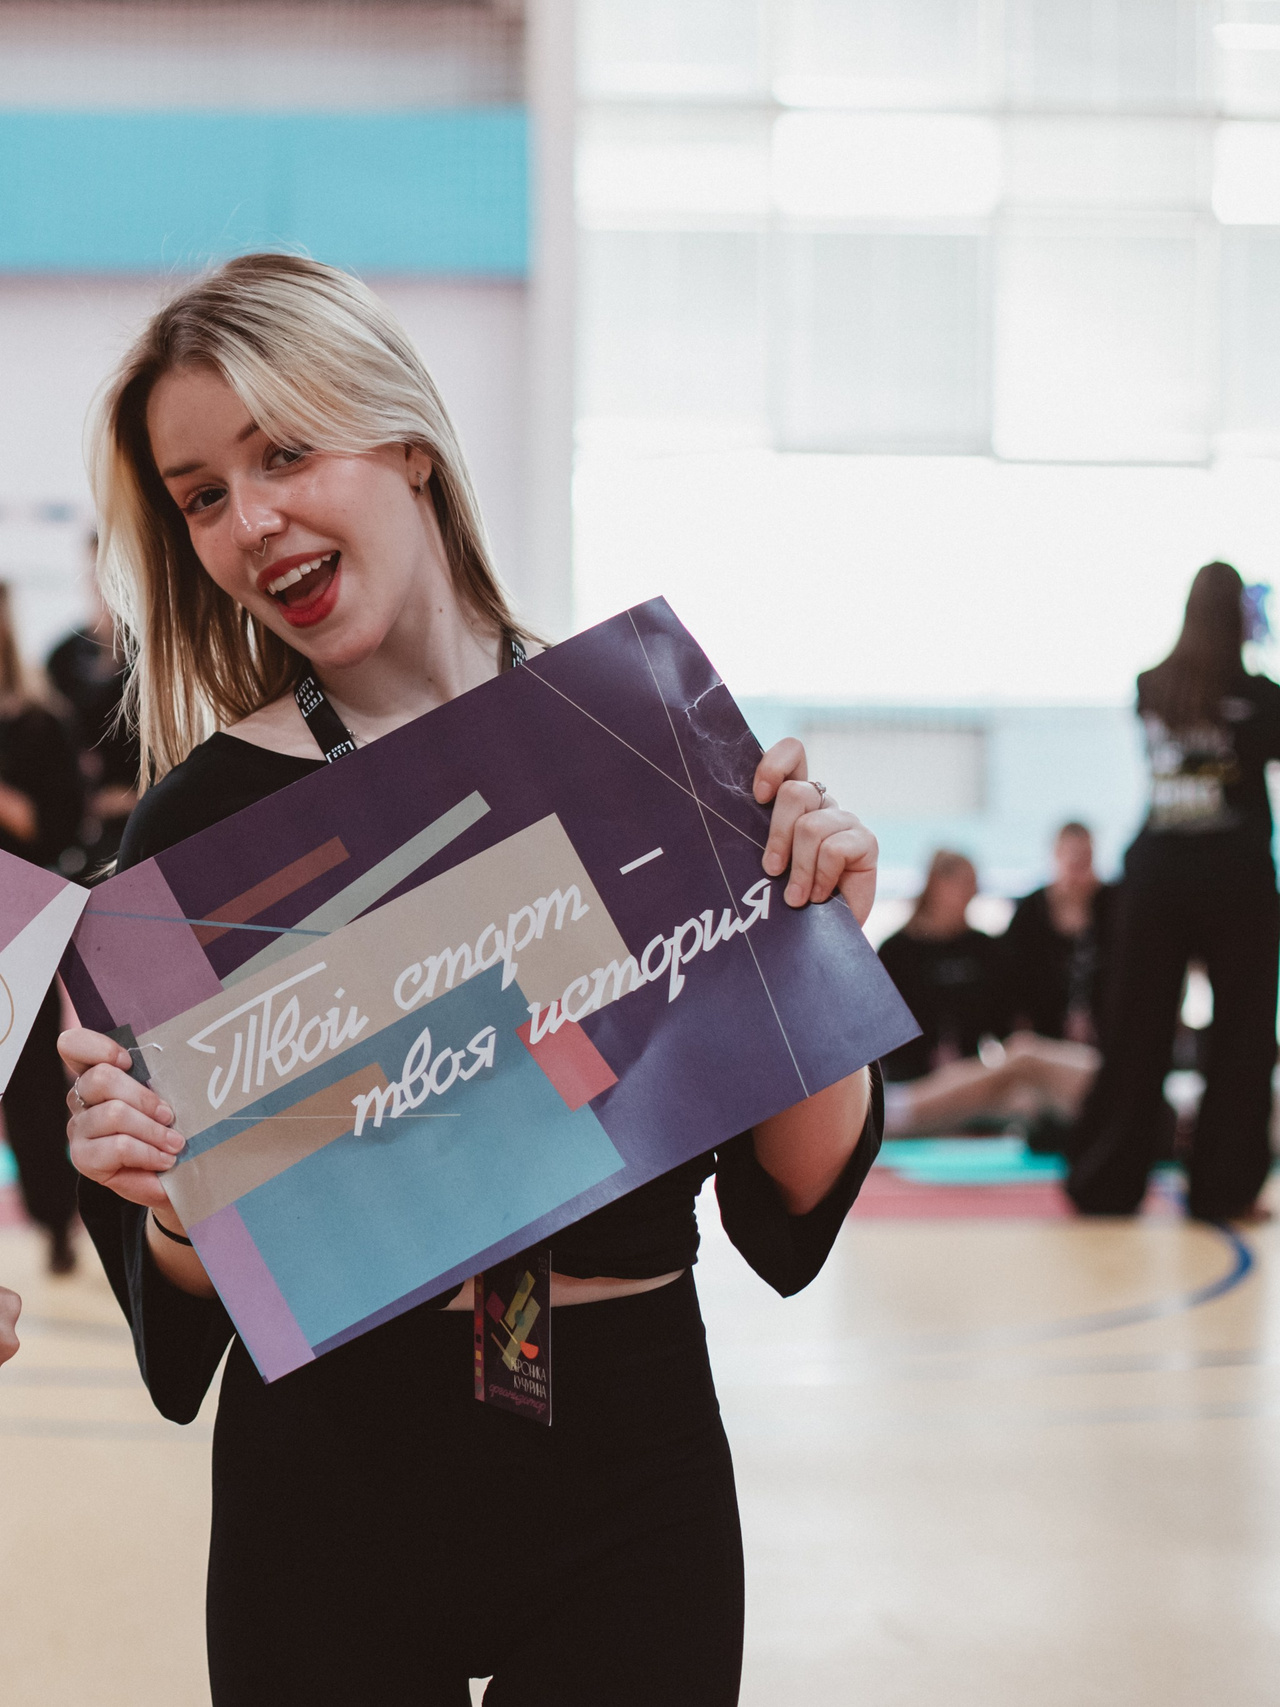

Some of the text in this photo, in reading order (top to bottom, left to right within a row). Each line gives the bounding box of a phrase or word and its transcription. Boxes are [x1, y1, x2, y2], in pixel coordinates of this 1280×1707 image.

[186, 961, 370, 1110] Твой
[393, 883, 590, 1011] старт
[351, 877, 772, 1137] твоя история
